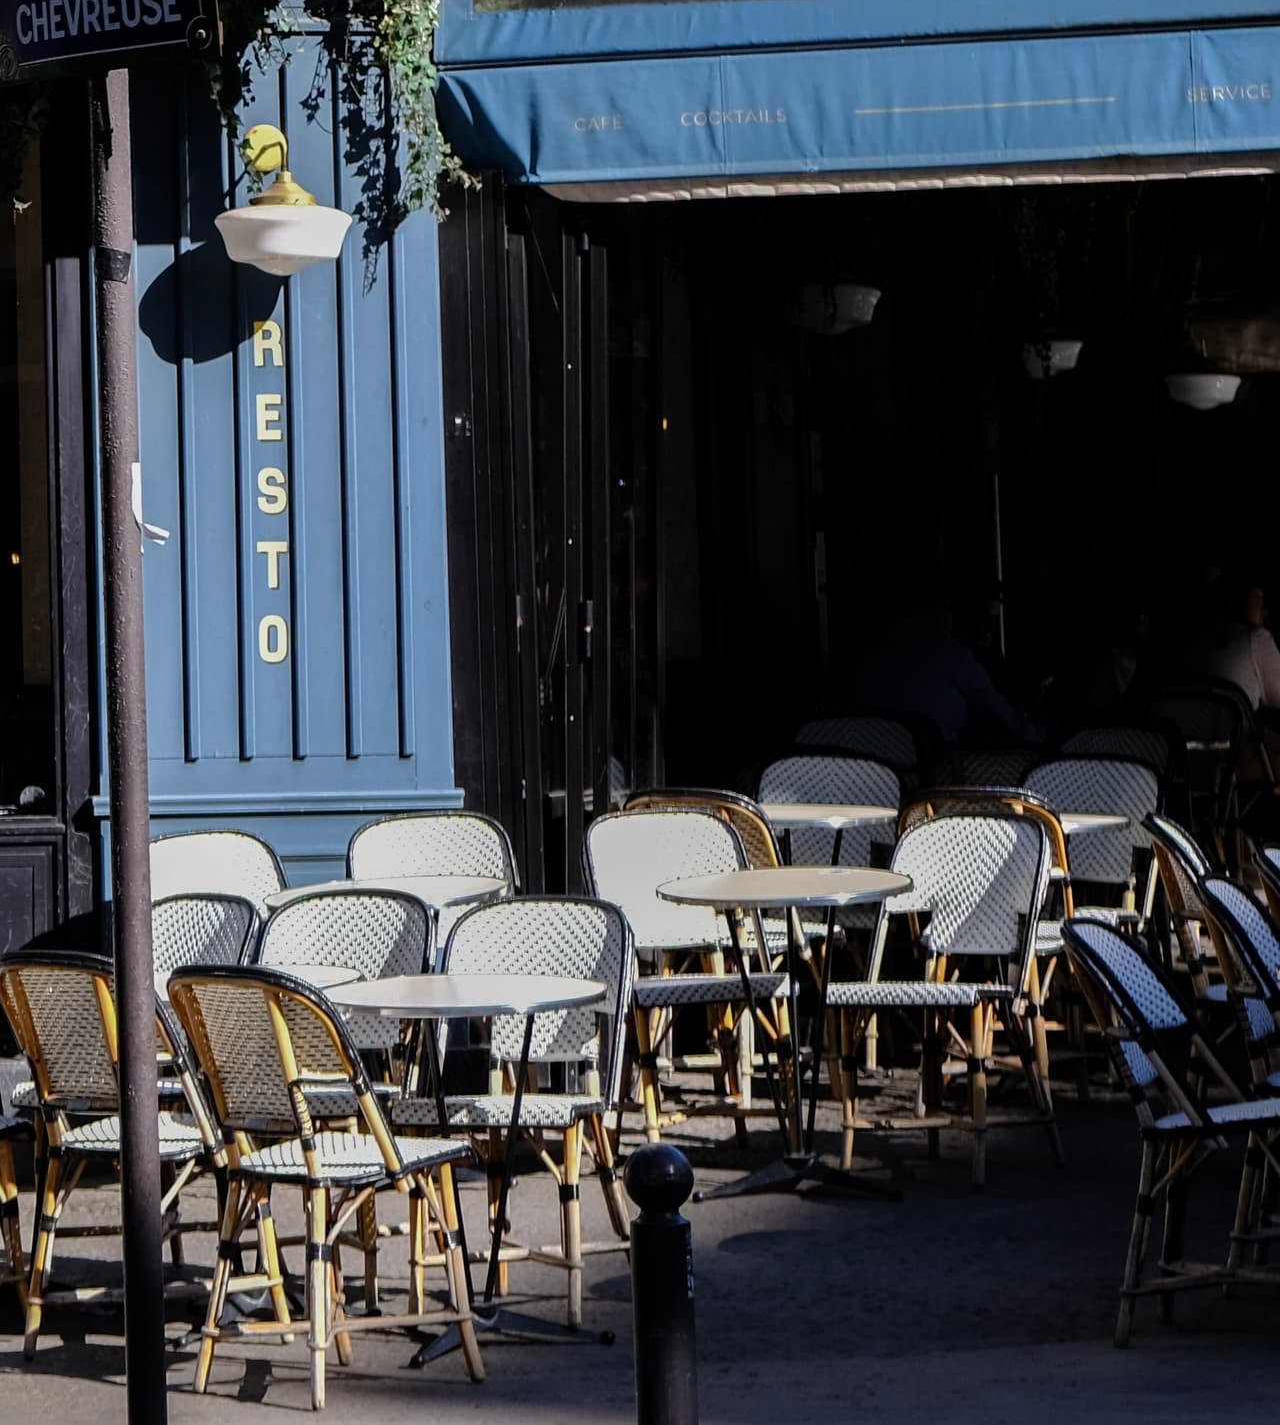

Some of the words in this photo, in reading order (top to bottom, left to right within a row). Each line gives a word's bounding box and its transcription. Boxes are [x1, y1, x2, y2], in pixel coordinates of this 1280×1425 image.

[679, 107, 788, 127] COCKTAILS
[1186, 83, 1273, 104] SERVICE
[252, 319, 290, 665] RESTO
